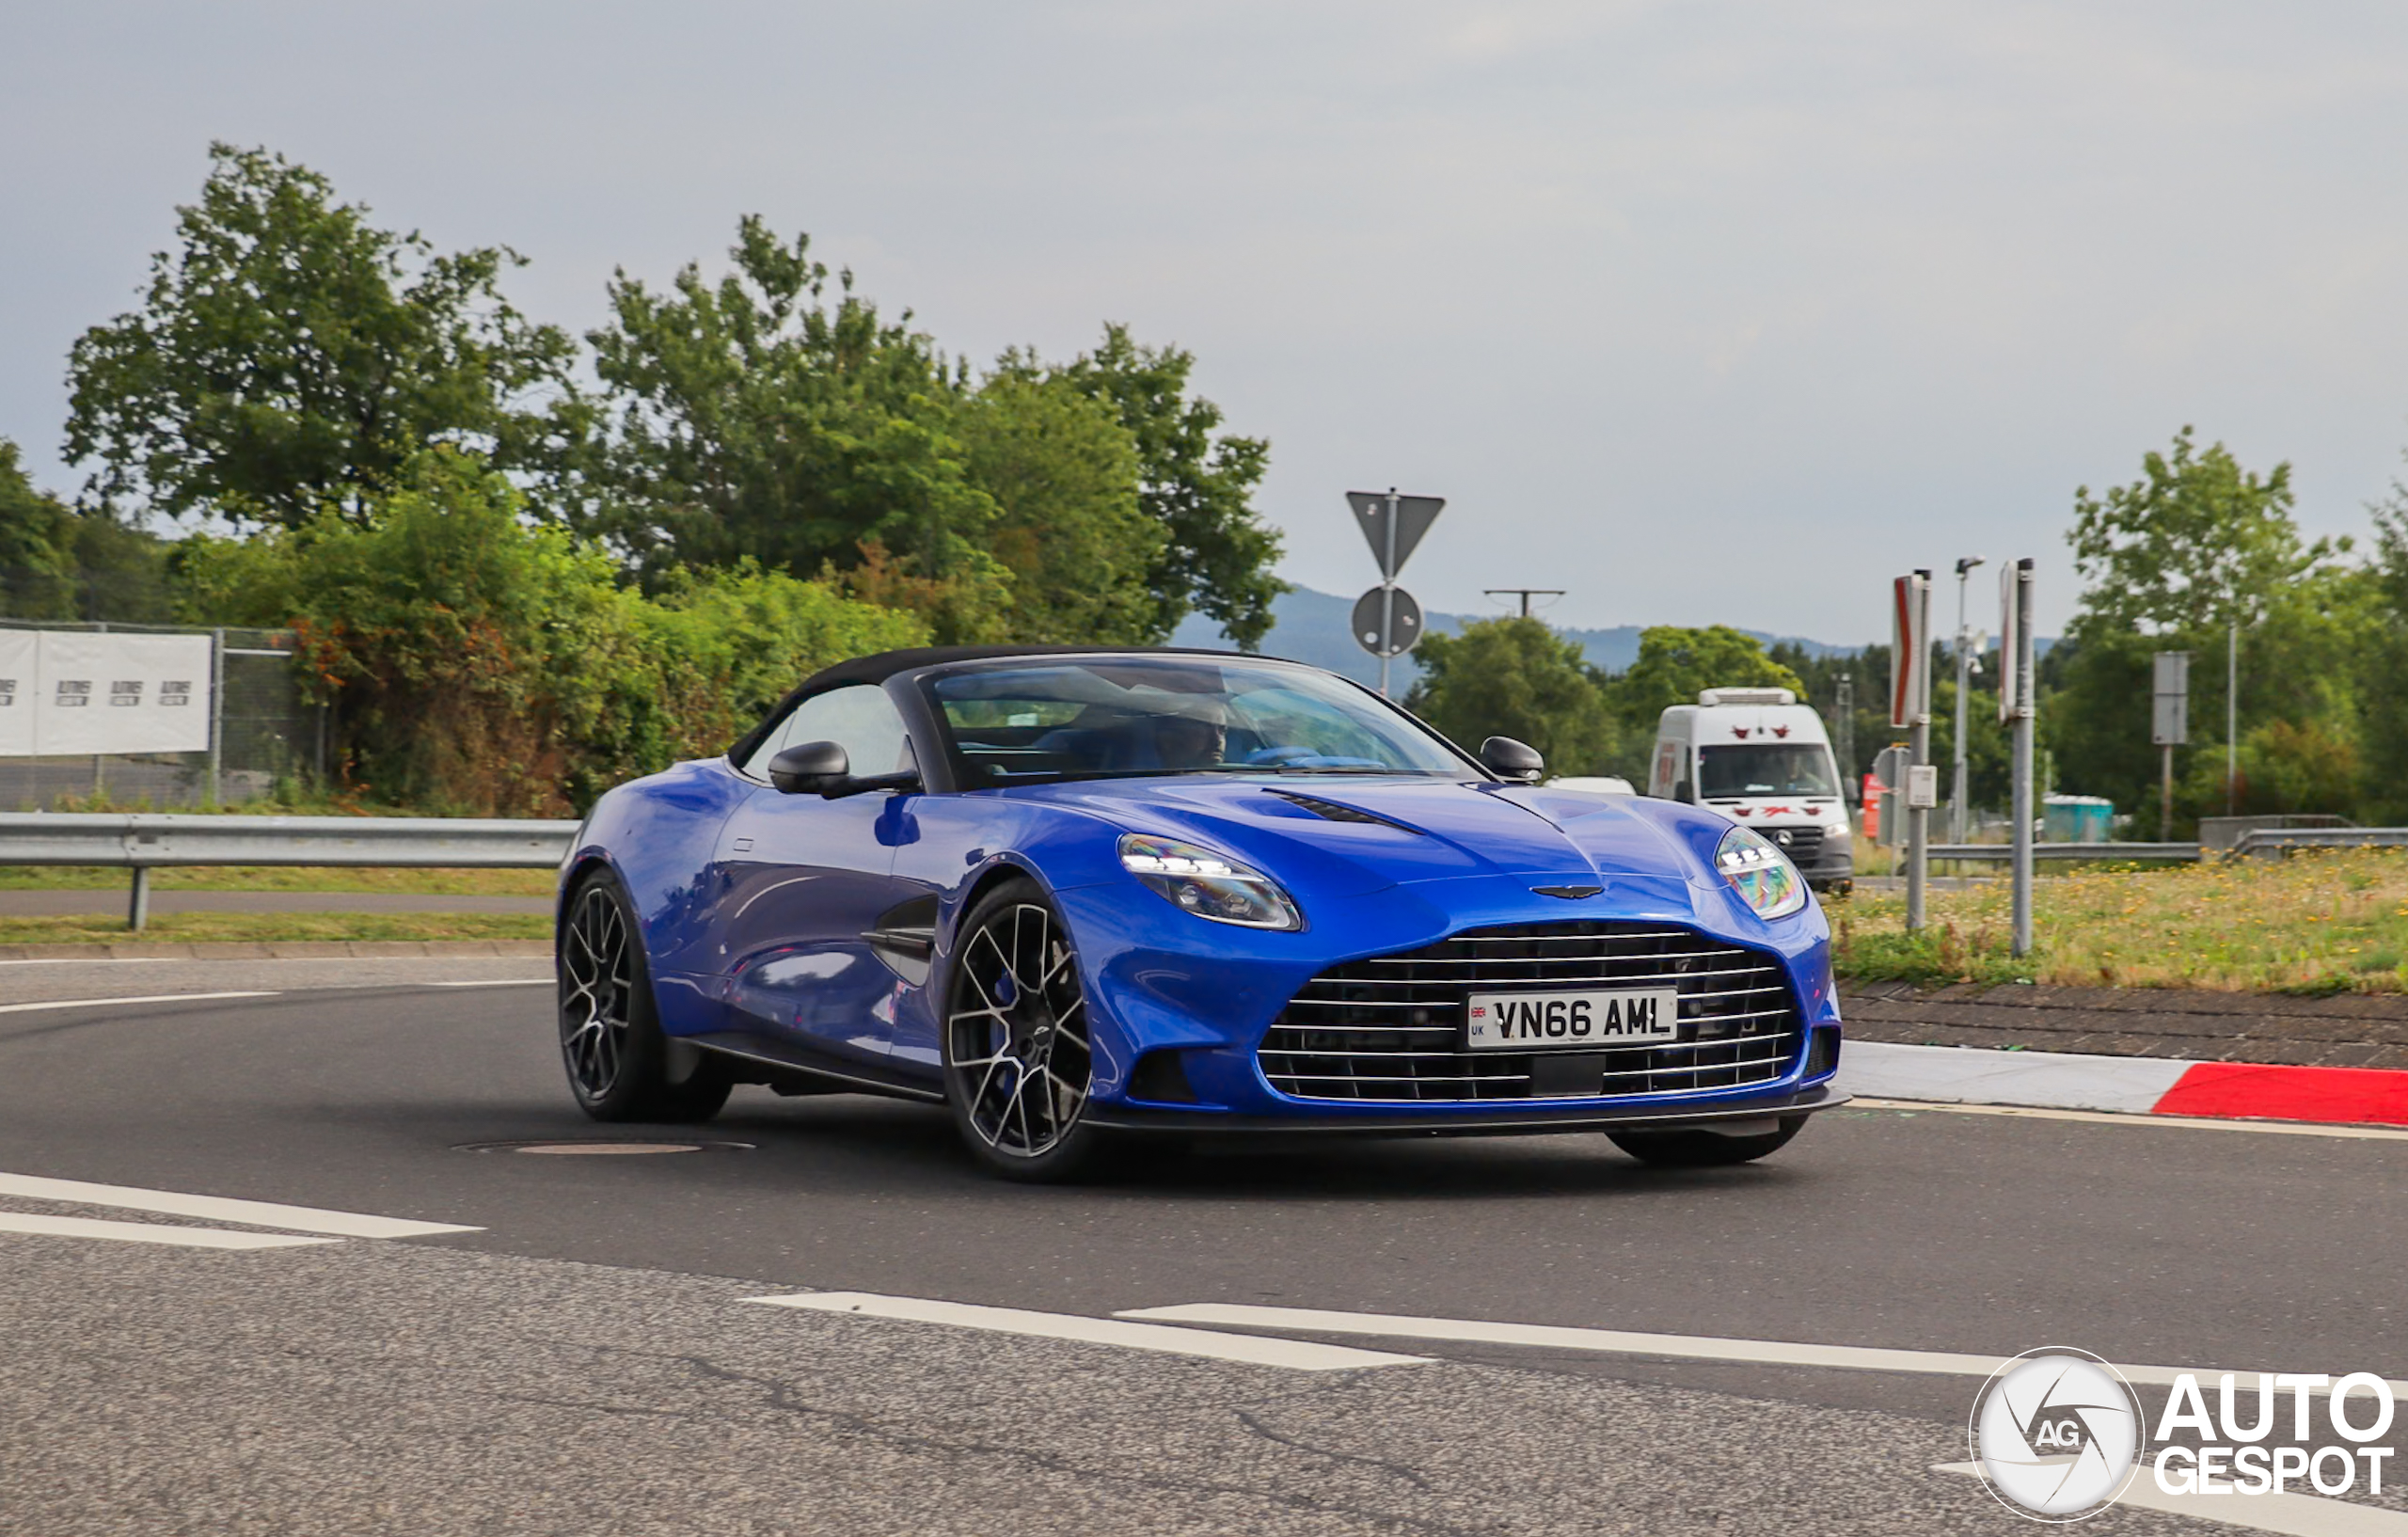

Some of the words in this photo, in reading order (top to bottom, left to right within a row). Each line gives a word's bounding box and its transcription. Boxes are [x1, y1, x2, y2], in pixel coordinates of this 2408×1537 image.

[1471, 1024, 1484, 1036] UK
[1493, 999, 1592, 1039] VN66
[1603, 997, 1671, 1036] AML
